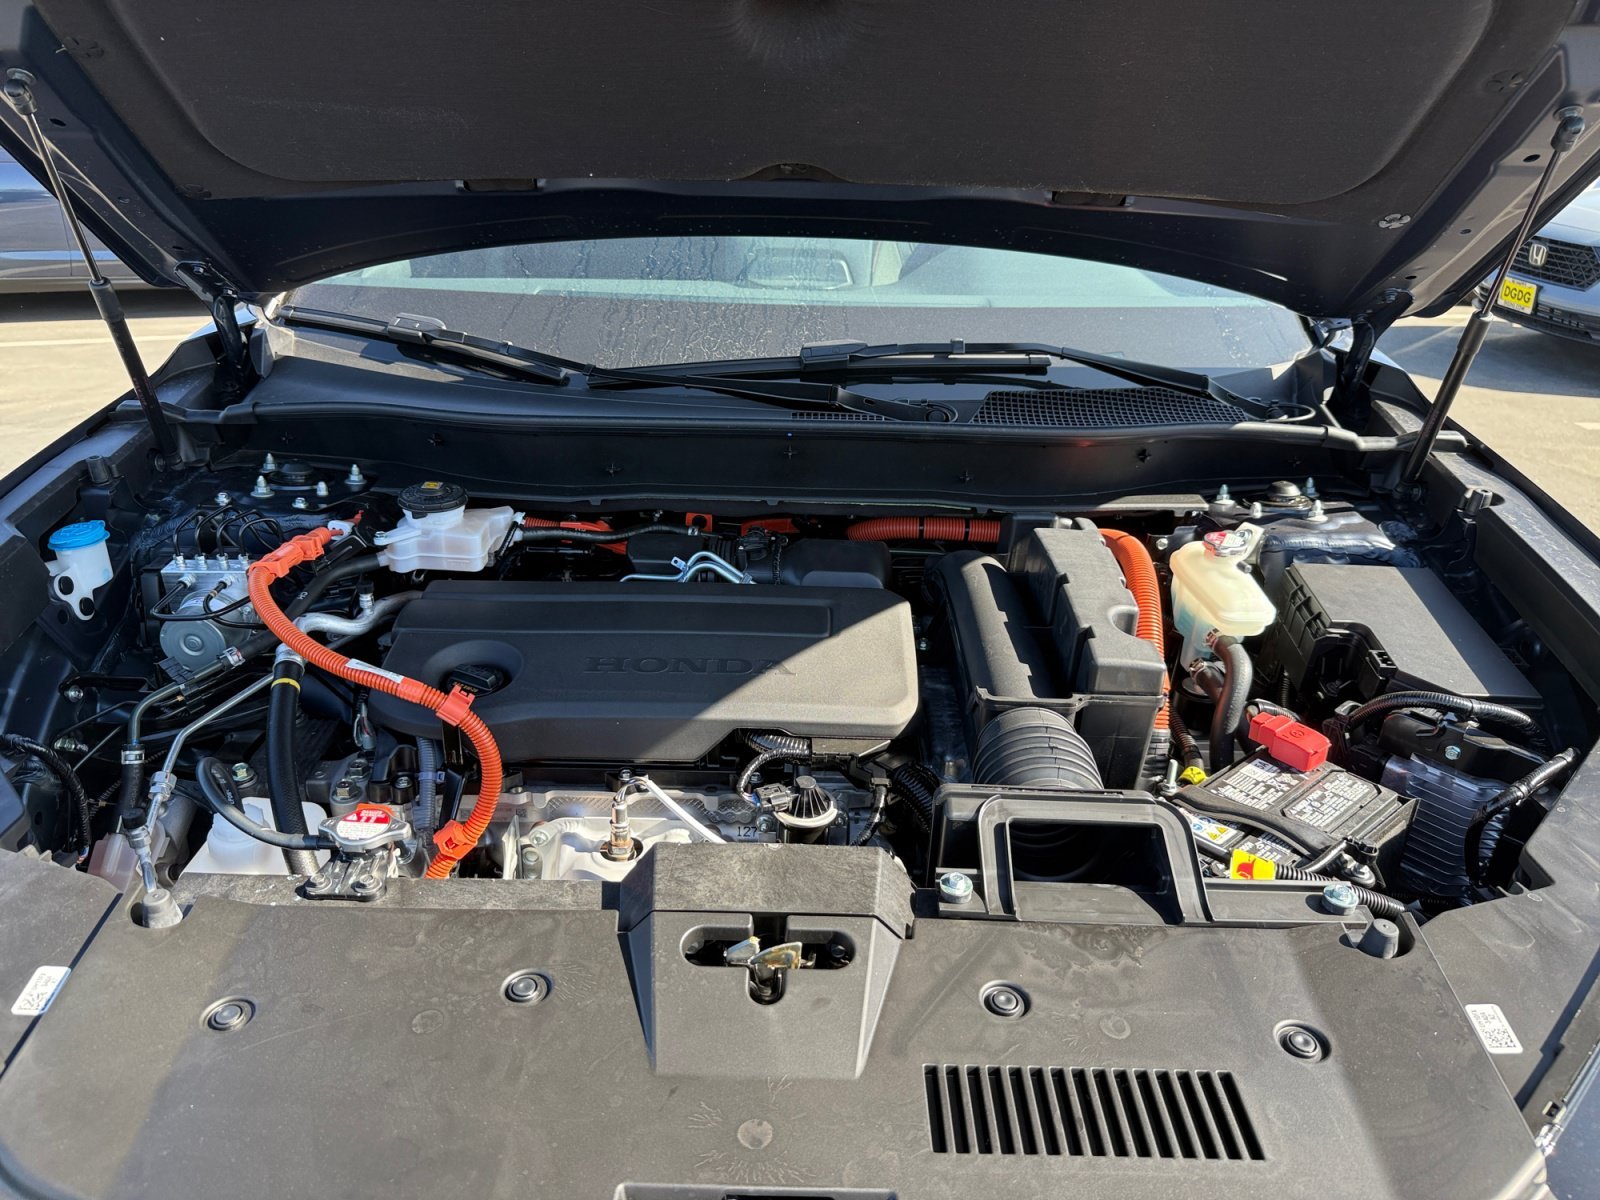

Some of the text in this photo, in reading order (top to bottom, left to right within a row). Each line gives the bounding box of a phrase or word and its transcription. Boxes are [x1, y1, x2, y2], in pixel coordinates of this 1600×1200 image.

[1503, 286, 1531, 303] DGDG
[583, 656, 797, 676] HONDA
[737, 826, 758, 838] 127
